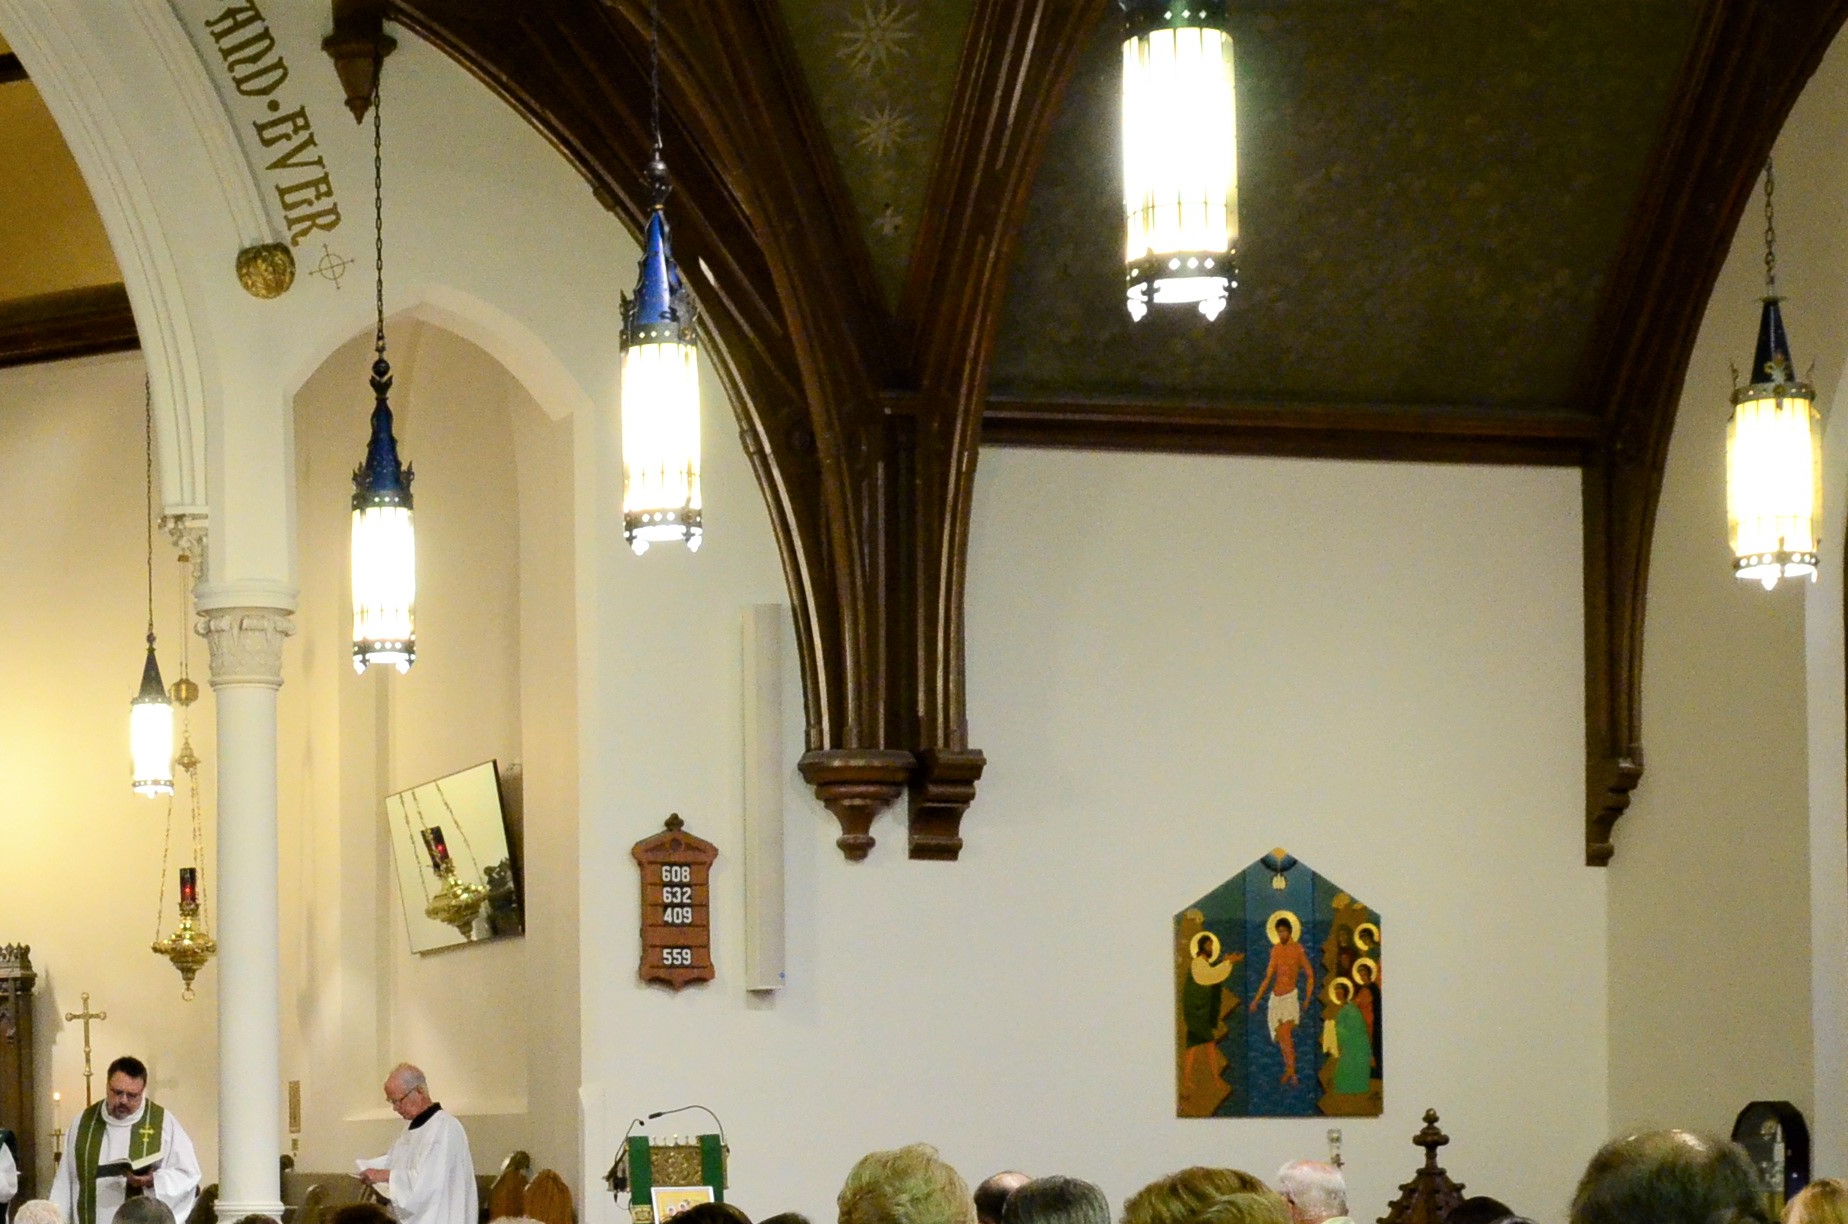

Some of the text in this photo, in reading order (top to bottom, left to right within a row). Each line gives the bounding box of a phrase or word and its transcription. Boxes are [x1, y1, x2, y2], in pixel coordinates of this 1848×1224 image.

[204, 0, 342, 247] AND EVER
[662, 865, 690, 882] 608
[663, 887, 691, 903] 632
[663, 907, 692, 924] 409
[663, 948, 691, 965] 559
